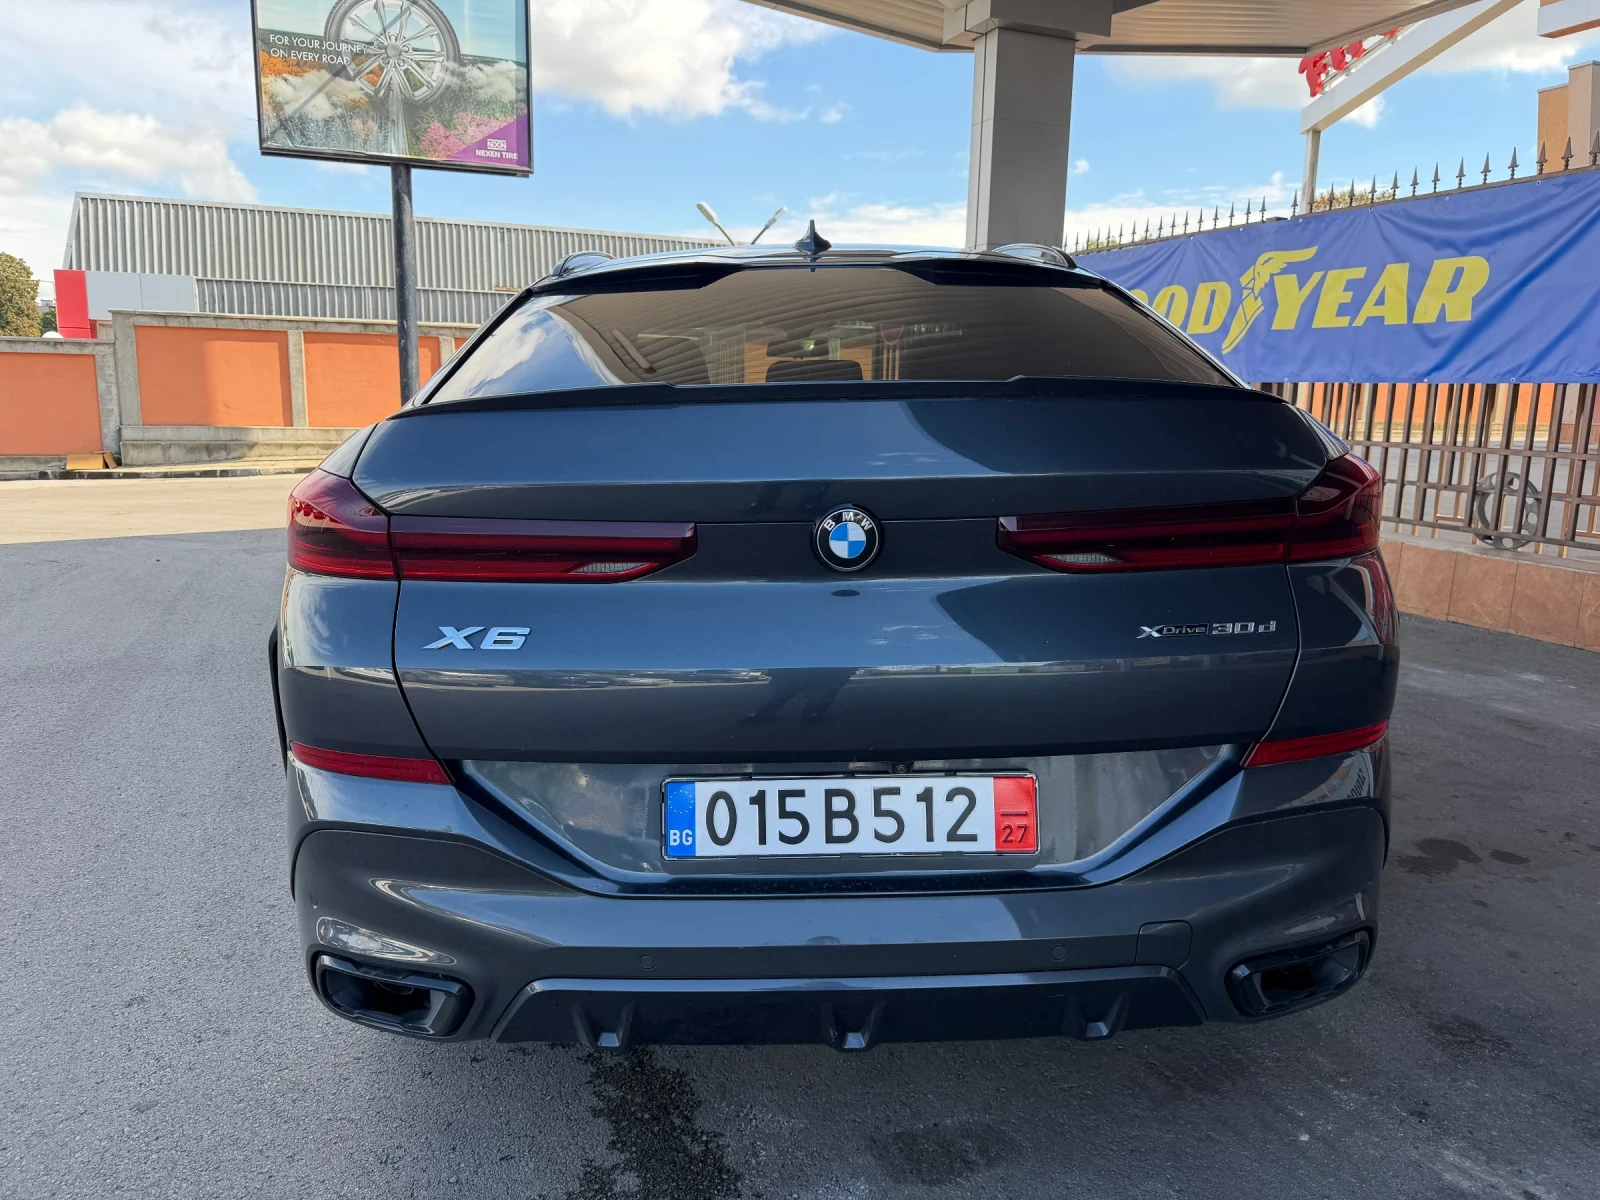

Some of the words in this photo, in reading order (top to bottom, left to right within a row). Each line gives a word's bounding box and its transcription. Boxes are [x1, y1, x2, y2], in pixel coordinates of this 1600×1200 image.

[270, 34, 290, 46] FOR
[292, 37, 320, 49] YOUR
[321, 40, 368, 54] JOURNEY
[270, 47, 288, 58] ON
[291, 50, 320, 62] EVERY
[322, 53, 351, 65] ROAD
[476, 149, 500, 158] NEXEN
[502, 152, 518, 160] TIRE
[1130, 255, 1490, 335] ODYEAR
[823, 511, 873, 531] BMW
[422, 626, 531, 650] X6
[669, 829, 693, 846] BG
[1001, 823, 1028, 843] 27
